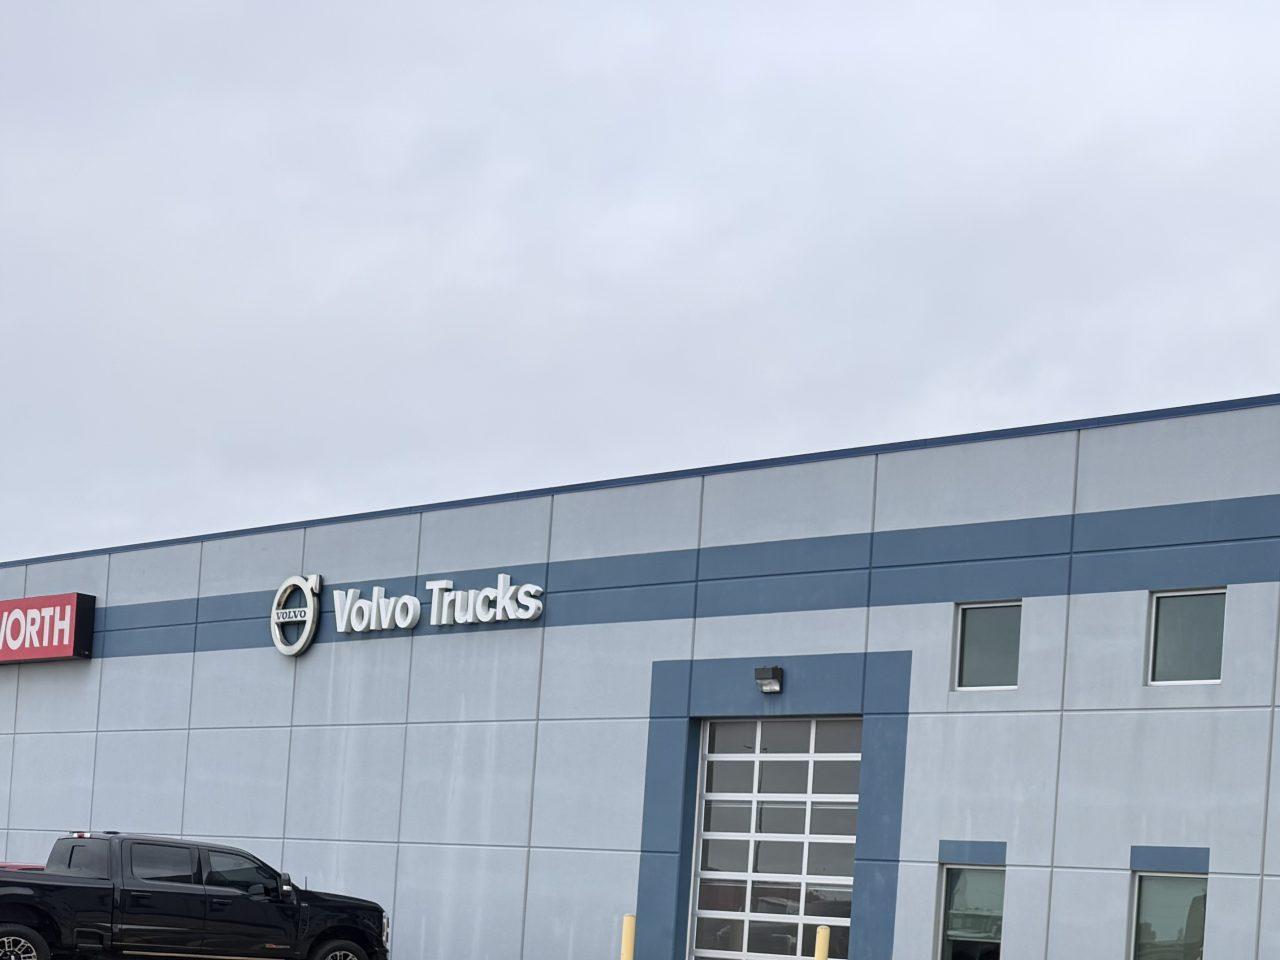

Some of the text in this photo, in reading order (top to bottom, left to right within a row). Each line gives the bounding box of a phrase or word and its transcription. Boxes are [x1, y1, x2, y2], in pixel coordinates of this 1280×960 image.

[276, 609, 307, 621] VOLVO
[333, 574, 544, 633] Volvo Trucks
